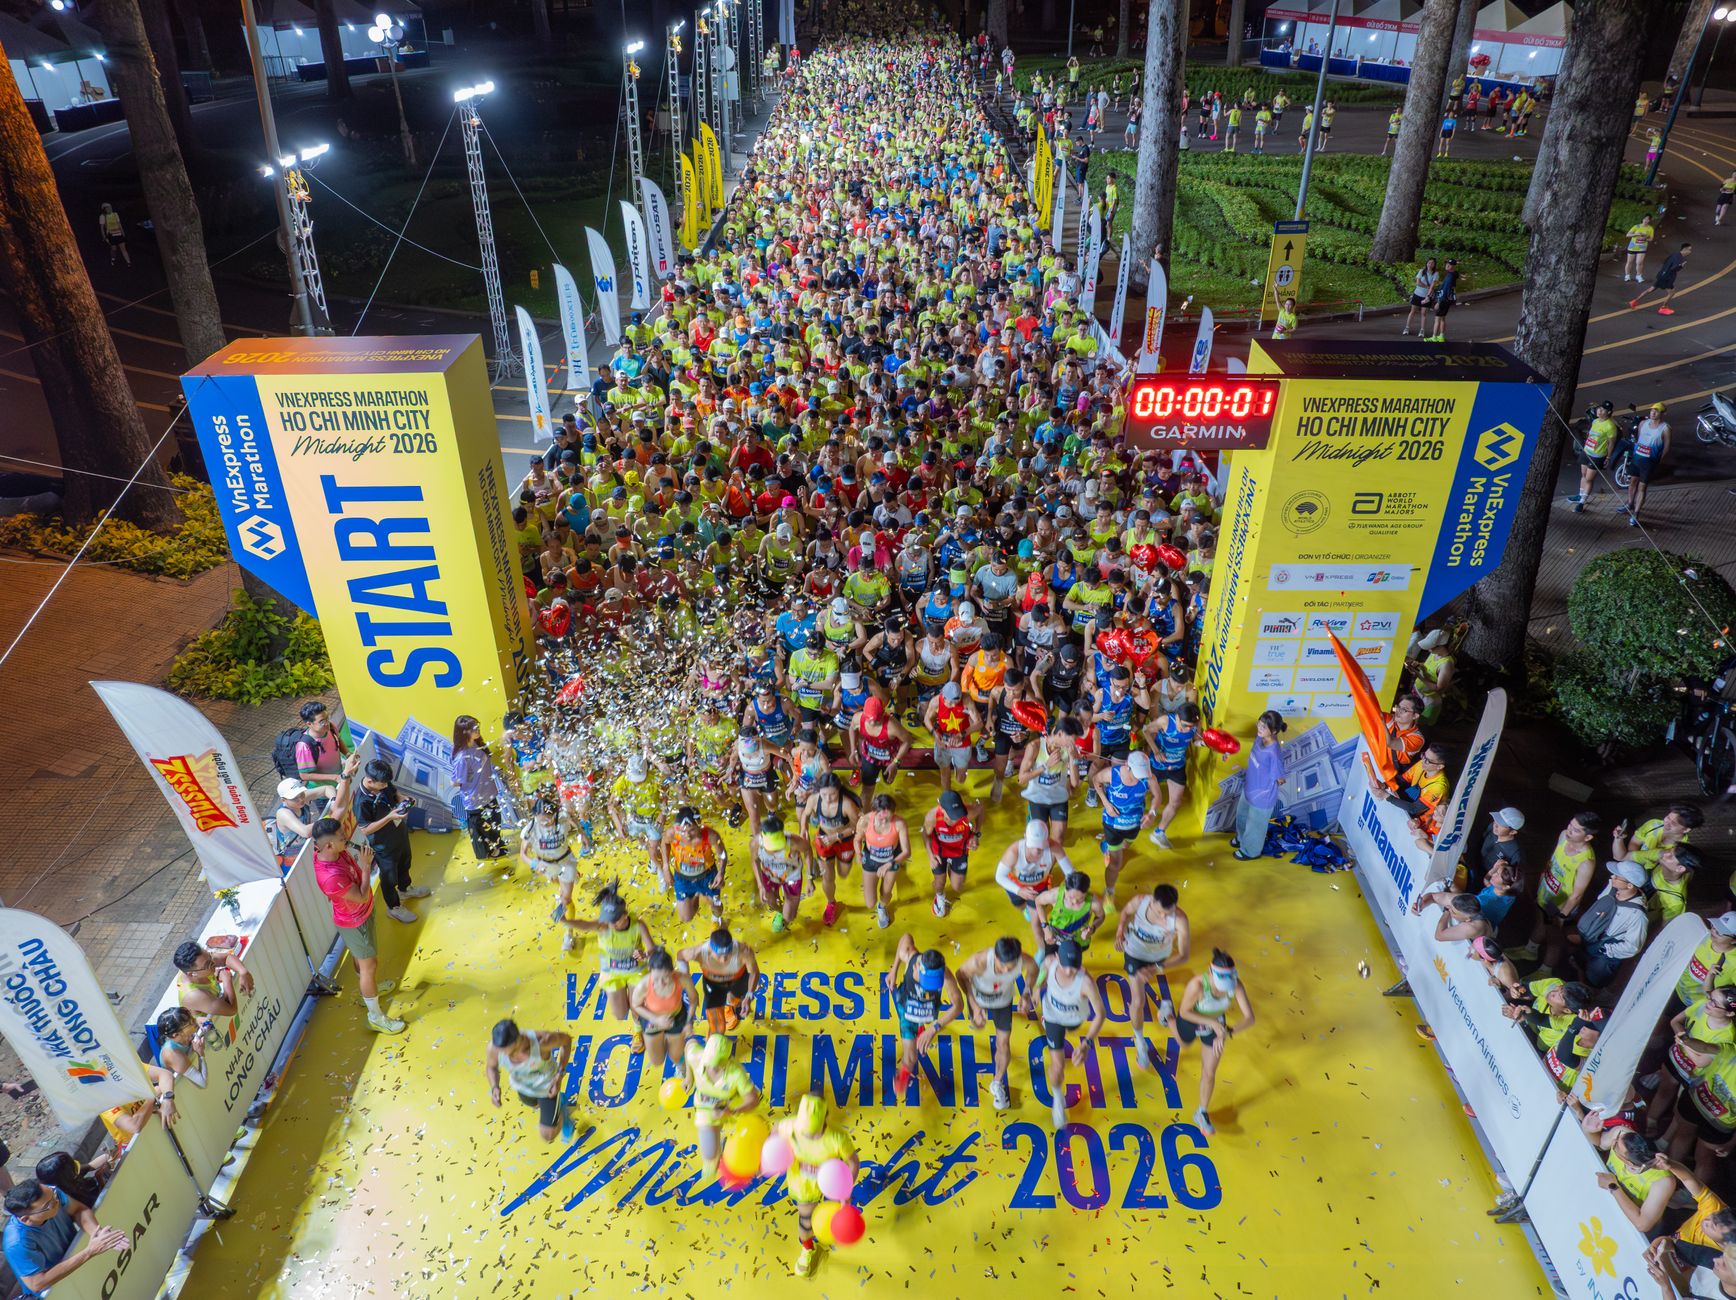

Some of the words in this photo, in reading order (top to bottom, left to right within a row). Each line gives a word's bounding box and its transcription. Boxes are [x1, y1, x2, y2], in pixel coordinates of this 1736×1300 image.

[222, 351, 293, 364] 2026
[275, 391, 353, 408] VNEXPRESS
[355, 390, 429, 406] MARATHON
[279, 411, 307, 432] HO
[309, 411, 341, 431] CHI
[343, 410, 390, 431] MINH
[393, 410, 430, 430] CITY
[1134, 387, 1272, 417] 00:00:01
[1296, 416, 1323, 437] HO
[1326, 416, 1358, 437] CHI
[1359, 417, 1409, 437] MINH
[1410, 417, 1451, 438] CITY
[1302, 397, 1378, 413] VNEXPRESS
[1380, 398, 1456, 414] MARATHON
[240, 413, 273, 510] Marathon
[291, 435, 387, 462] Midnight
[389, 433, 437, 454] 2026
[1150, 425, 1242, 439] GARMIN
[1292, 440, 1395, 468] Midnight
[1396, 440, 1445, 460] 2026
[212, 414, 250, 514] VnExpress
[1447, 476, 1486, 568] Marathon
[1469, 473, 1511, 568] VnExpress
[320, 474, 463, 689] START
[1362, 789, 1413, 906] Vinamilk
[18, 937, 67, 997] CHÂU
[4, 973, 52, 1033] THUỐC
[57, 998, 102, 1054] LONG
[224, 1052, 255, 1113] LONG
[254, 998, 281, 1053] CHÂU
[225, 1046, 244, 1081] NHÀ
[242, 996, 270, 1046] THUỐC
[1447, 976, 1479, 1041] Vietnam
[1477, 1038, 1509, 1096] Airlines
[808, 1034, 1011, 1107] MINH
[1028, 1034, 1183, 1109] CITY
[1004, 1121, 1224, 1211] 2026
